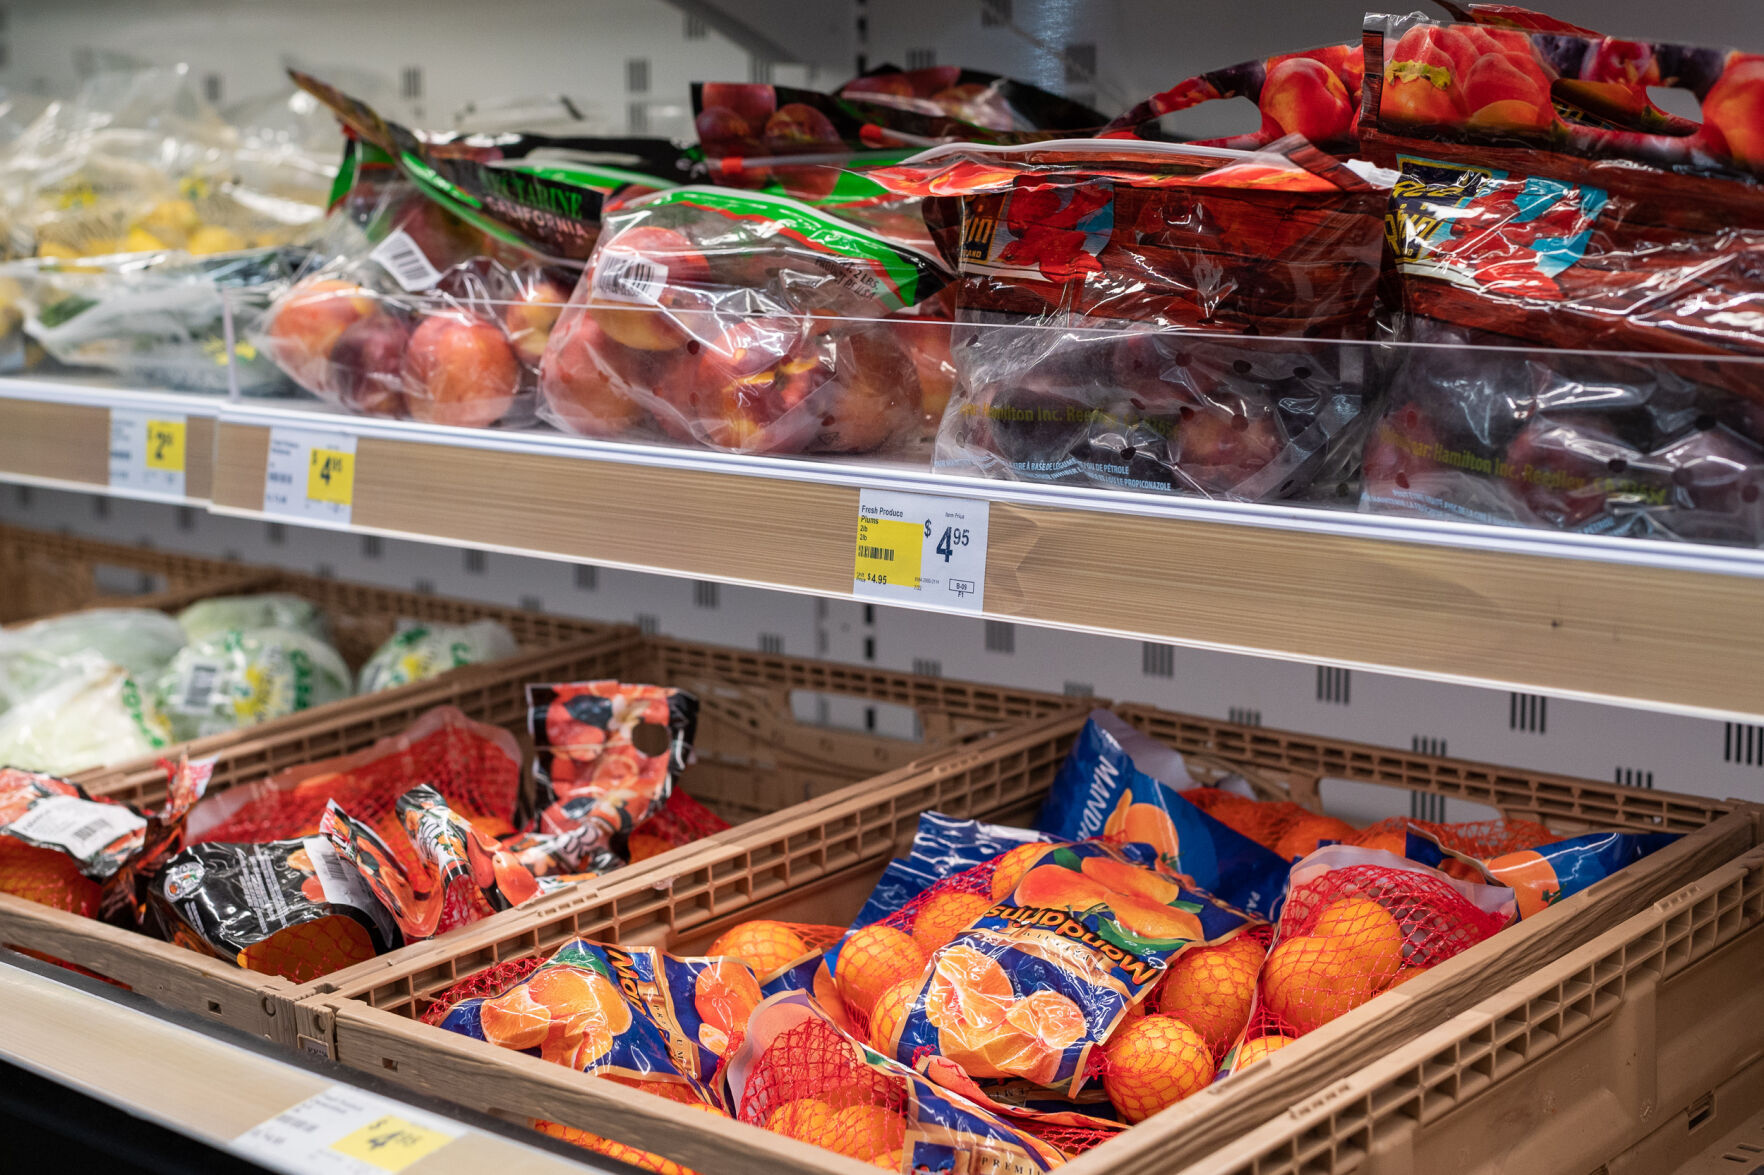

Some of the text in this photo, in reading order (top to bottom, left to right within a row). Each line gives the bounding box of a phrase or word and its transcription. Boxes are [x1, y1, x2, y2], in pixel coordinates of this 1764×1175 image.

[1037, 407, 1063, 422] Inc.
[1433, 442, 1492, 473] Hamilton
[1124, 478, 1172, 491] PROPICONAZOLE
[860, 515, 879, 524] Plums
[861, 504, 903, 518] Fresh Produce
[1076, 755, 1119, 841] MANDA
[984, 904, 1158, 985] Mandarins
[981, 1155, 1044, 1175] PREMI
